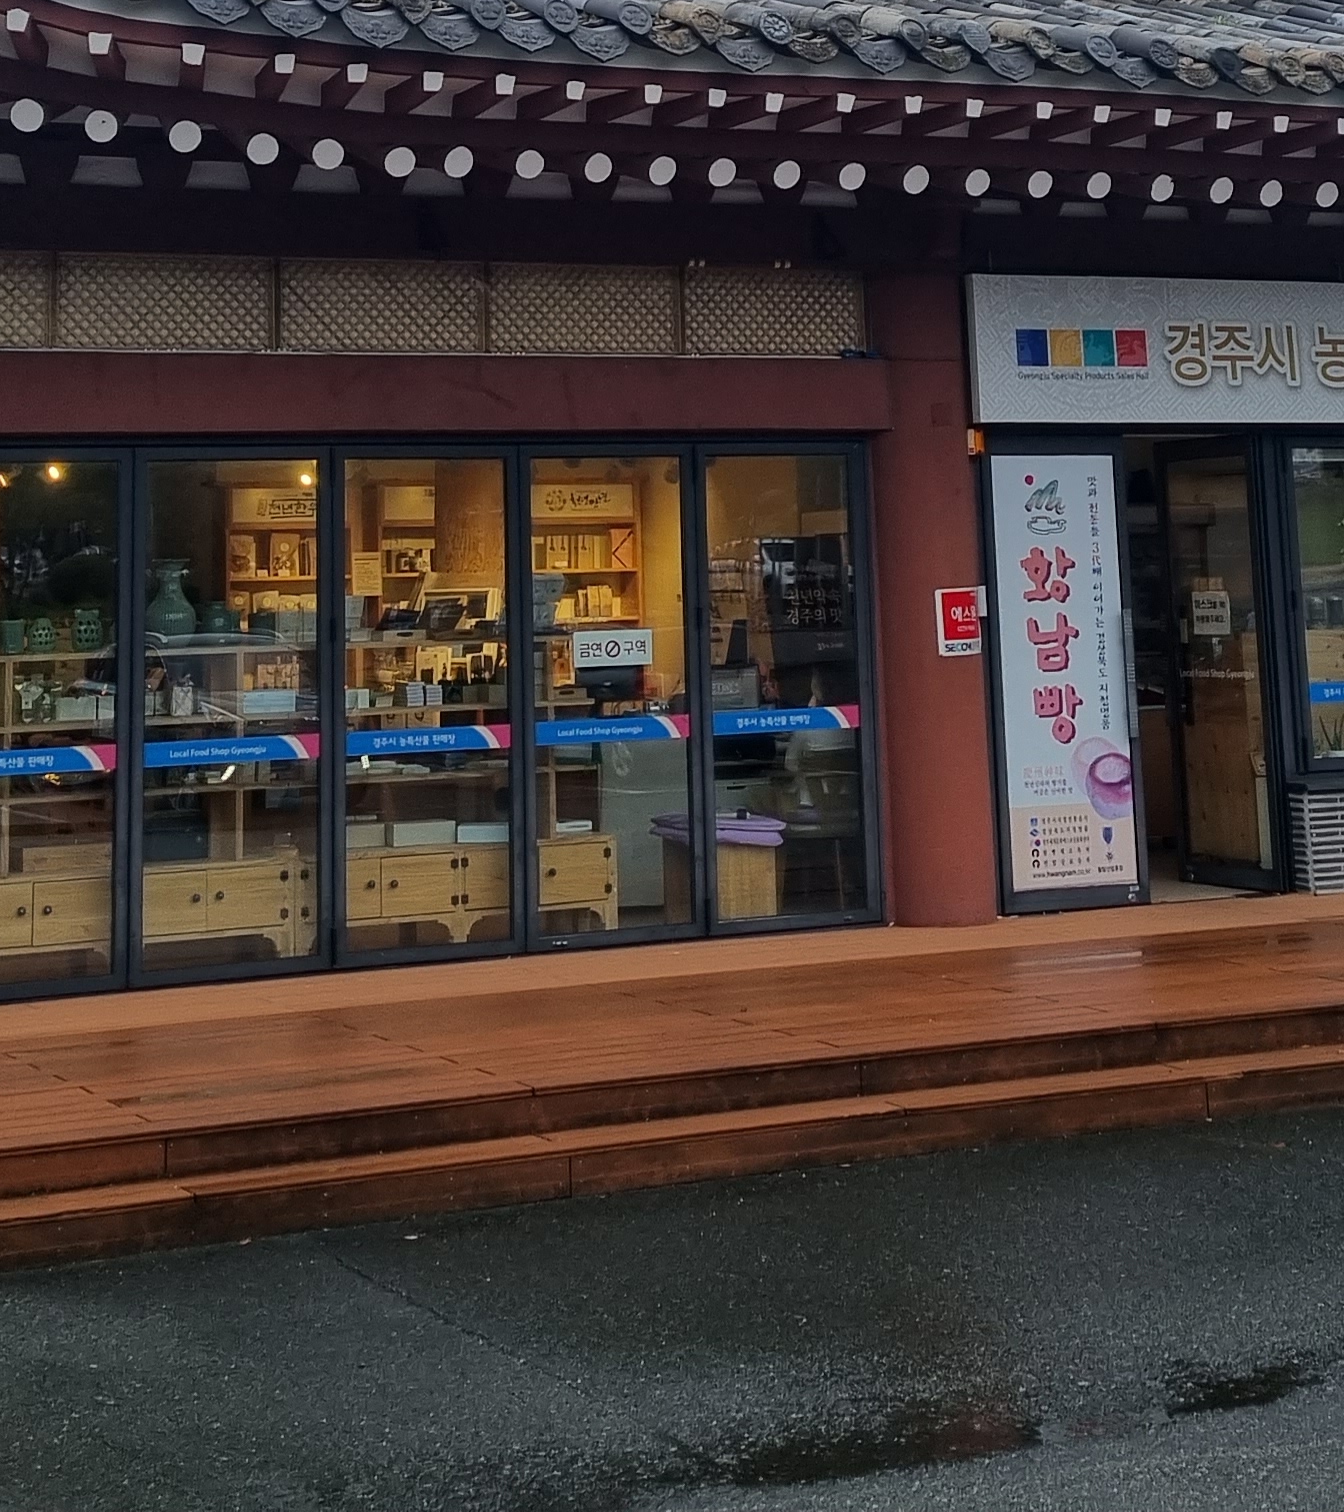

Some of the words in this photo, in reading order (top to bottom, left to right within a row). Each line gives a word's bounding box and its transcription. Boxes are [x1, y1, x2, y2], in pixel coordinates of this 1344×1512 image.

[1164, 322, 1300, 385] 경주시
[1084, 371, 1115, 380] Products
[1092, 582, 1105, 629] 이어가는
[786, 607, 827, 625] 경주의
[579, 642, 602, 659] 금연
[623, 640, 647, 656] 구역
[1019, 545, 1084, 745] 황남빵
[736, 717, 758, 729] 경주시
[789, 714, 811, 725] 판매장
[557, 729, 575, 737] Local
[576, 728, 593, 736] Food
[593, 727, 611, 736] Shop
[611, 725, 643, 736] Gyeongju
[373, 736, 397, 748] 경주시
[432, 733, 456, 745] 판매장
[169, 749, 190, 759] Local
[190, 747, 210, 758] Food
[210, 747, 230, 757] Shop
[230, 744, 267, 756] Gyeongju
[27, 755, 54, 768] 판매장
